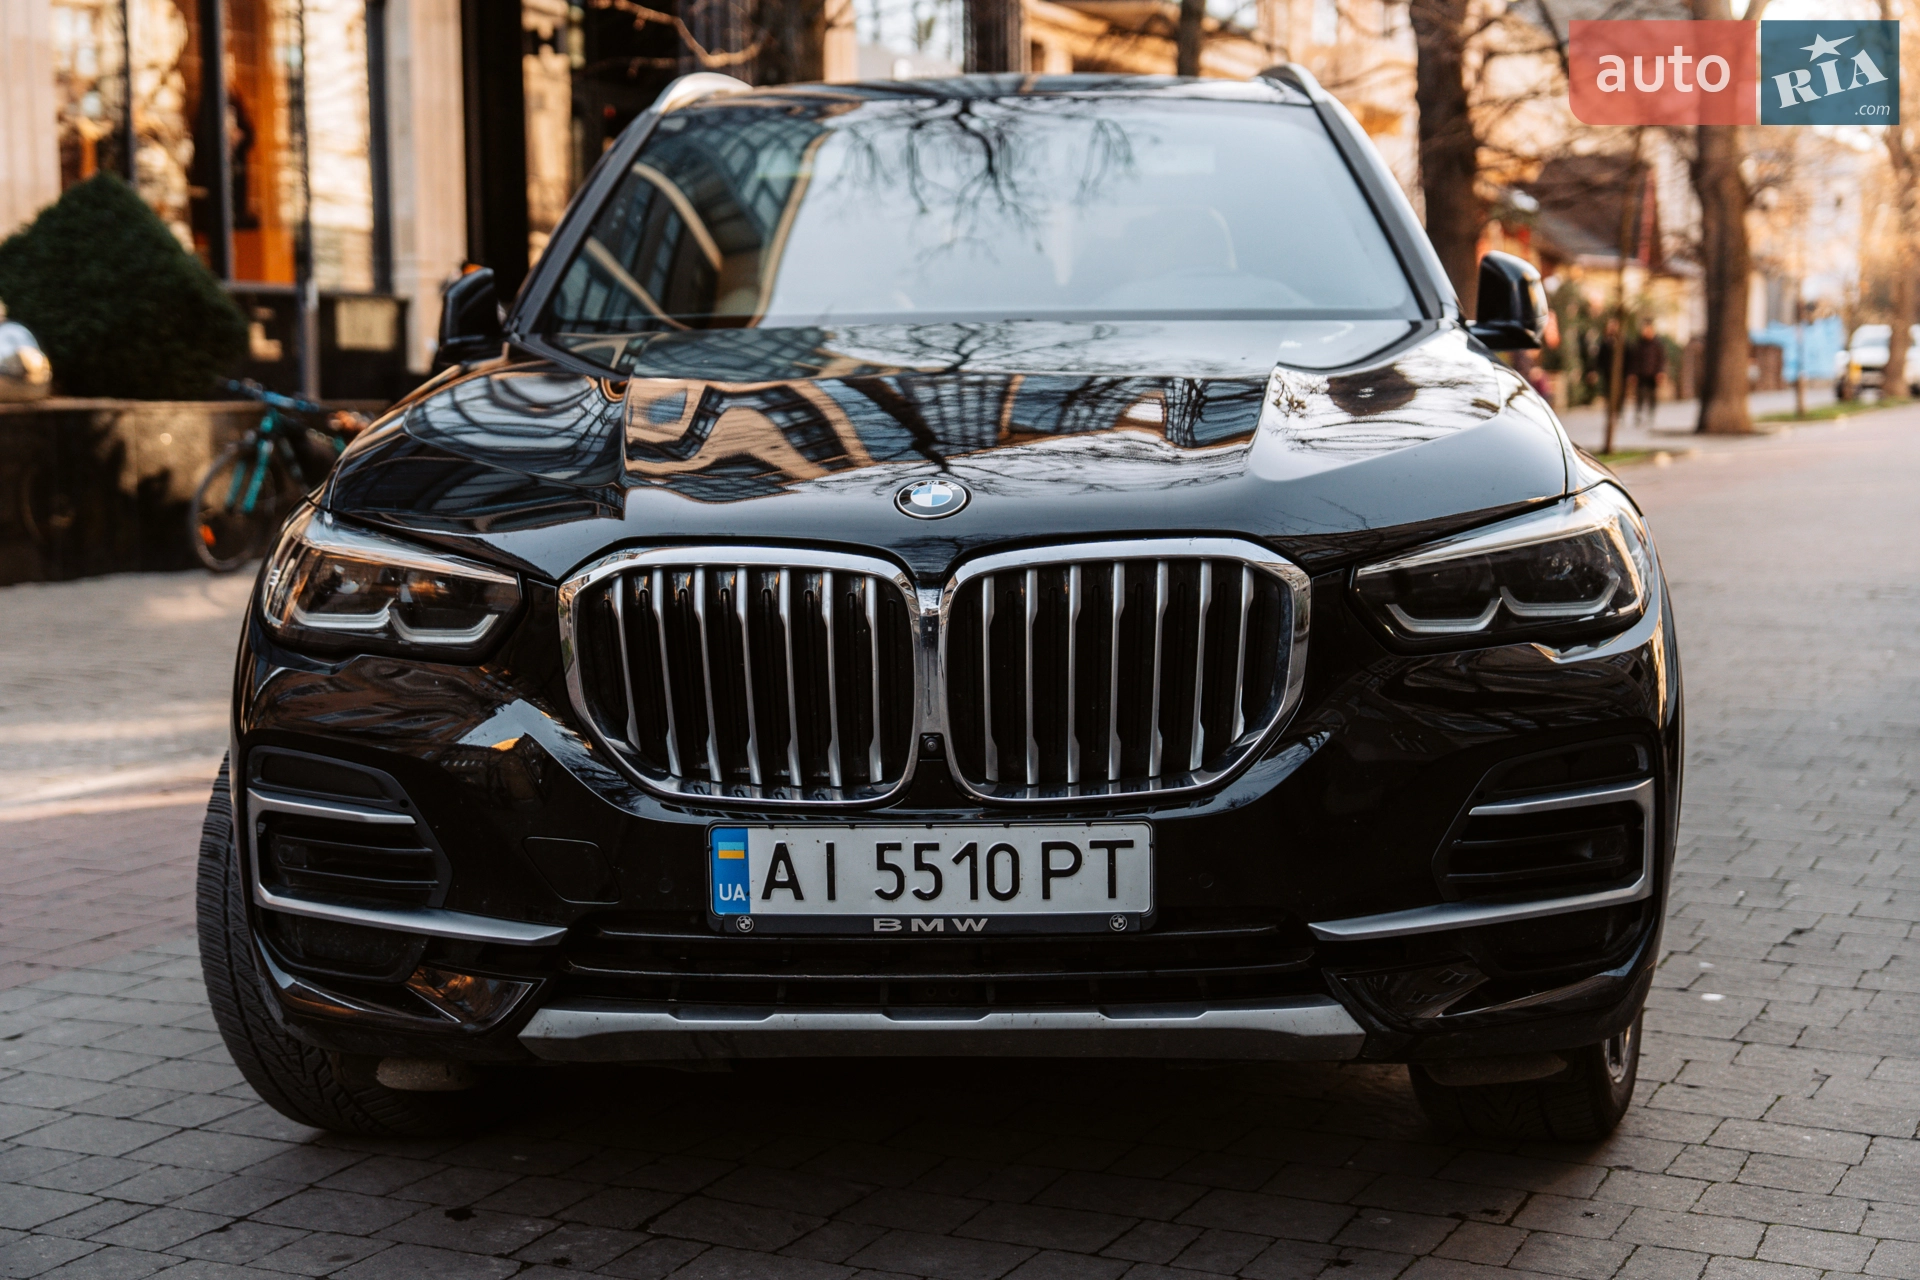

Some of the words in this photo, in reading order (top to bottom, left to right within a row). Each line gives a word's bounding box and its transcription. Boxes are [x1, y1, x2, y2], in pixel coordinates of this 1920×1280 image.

[761, 841, 836, 901] AI
[873, 841, 1021, 902] 5510
[1041, 839, 1135, 900] PT
[718, 883, 747, 901] UA
[873, 918, 988, 932] BMW
